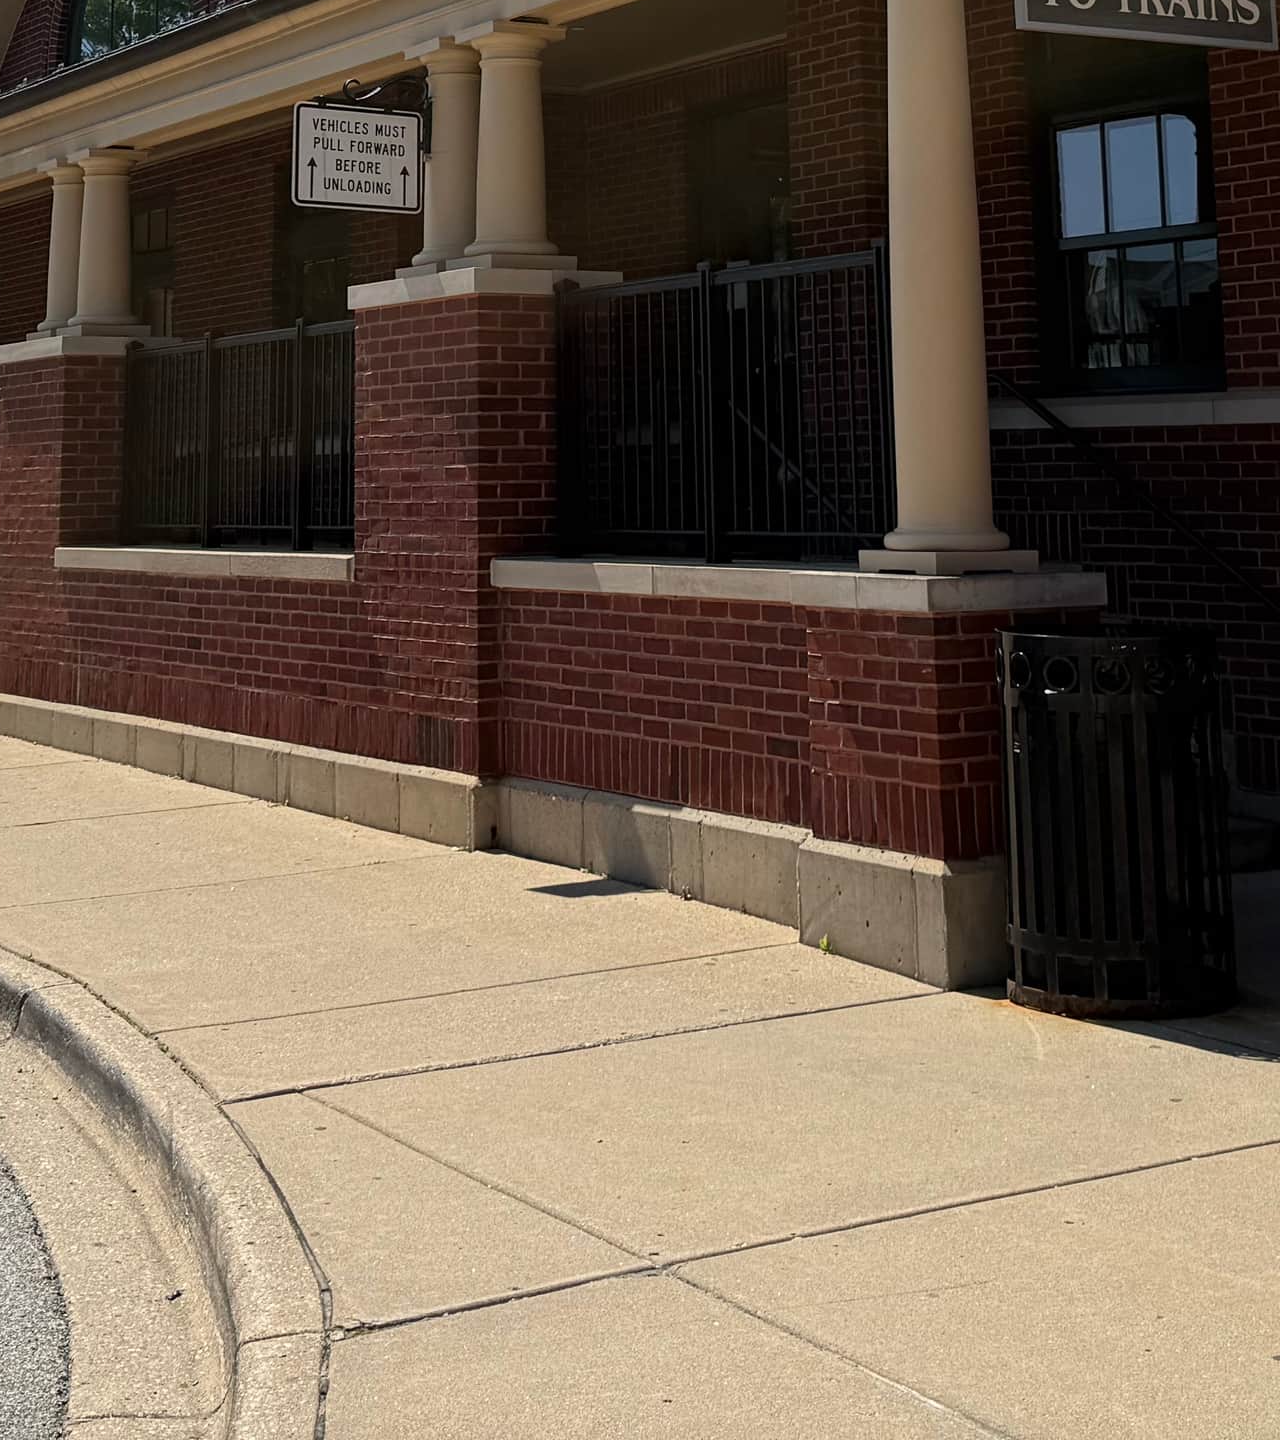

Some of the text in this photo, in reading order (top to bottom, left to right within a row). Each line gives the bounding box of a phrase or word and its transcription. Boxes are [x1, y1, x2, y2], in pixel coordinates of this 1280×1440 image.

[312, 117, 407, 139] VEHICLES MUST
[313, 136, 406, 157] PULL FORWARD
[335, 158, 382, 175] BEFORE
[323, 177, 392, 195] UNLOADING
